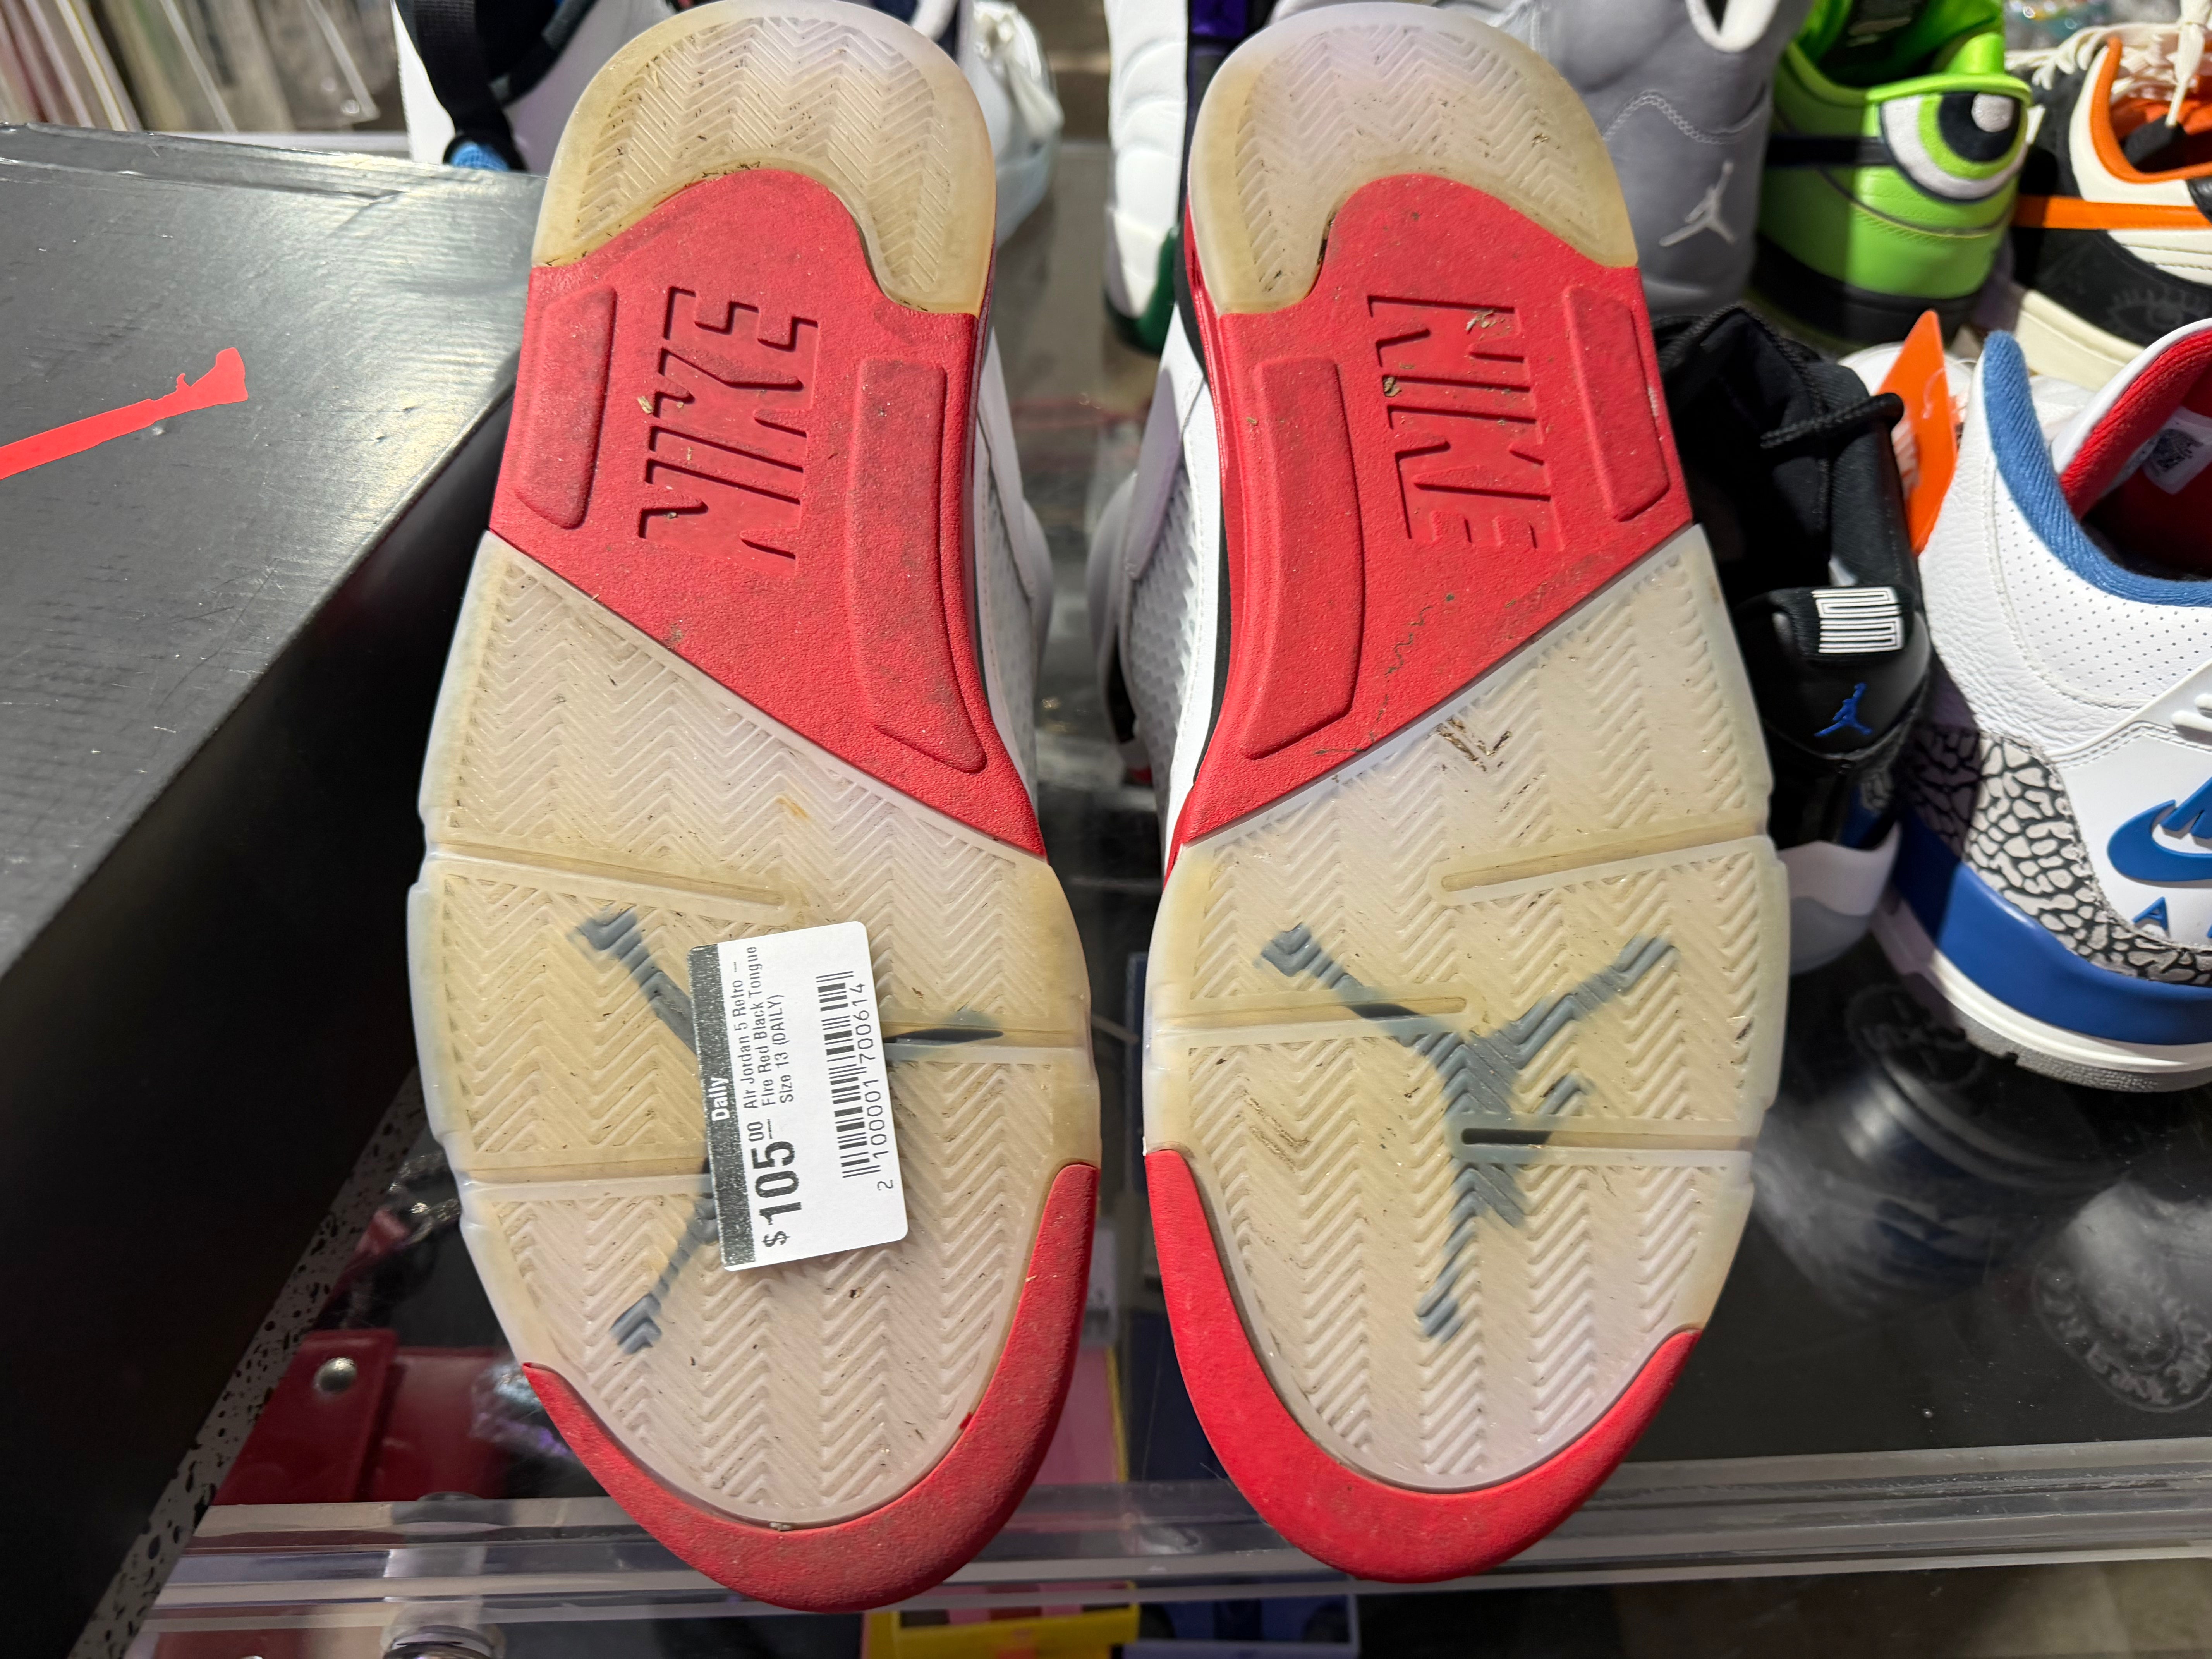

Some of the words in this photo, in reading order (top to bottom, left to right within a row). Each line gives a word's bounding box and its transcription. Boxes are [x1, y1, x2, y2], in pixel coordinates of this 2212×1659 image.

[638, 286, 820, 576] NIKE
[1367, 294, 1565, 551] NIKE
[747, 946, 763, 998] Tongue
[730, 980, 746, 1017] Retro
[734, 1022, 749, 1031] 5
[750, 1001, 768, 1040] Black
[767, 994, 790, 1045] (DAILY)
[737, 1036, 755, 1085] Jordan
[755, 1045, 772, 1073] Red
[775, 1052, 790, 1068] 13
[708, 1077, 730, 1121] Daily
[743, 1089, 758, 1109] Air
[761, 1079, 776, 1106] Fire
[779, 1074, 794, 1104] Size
